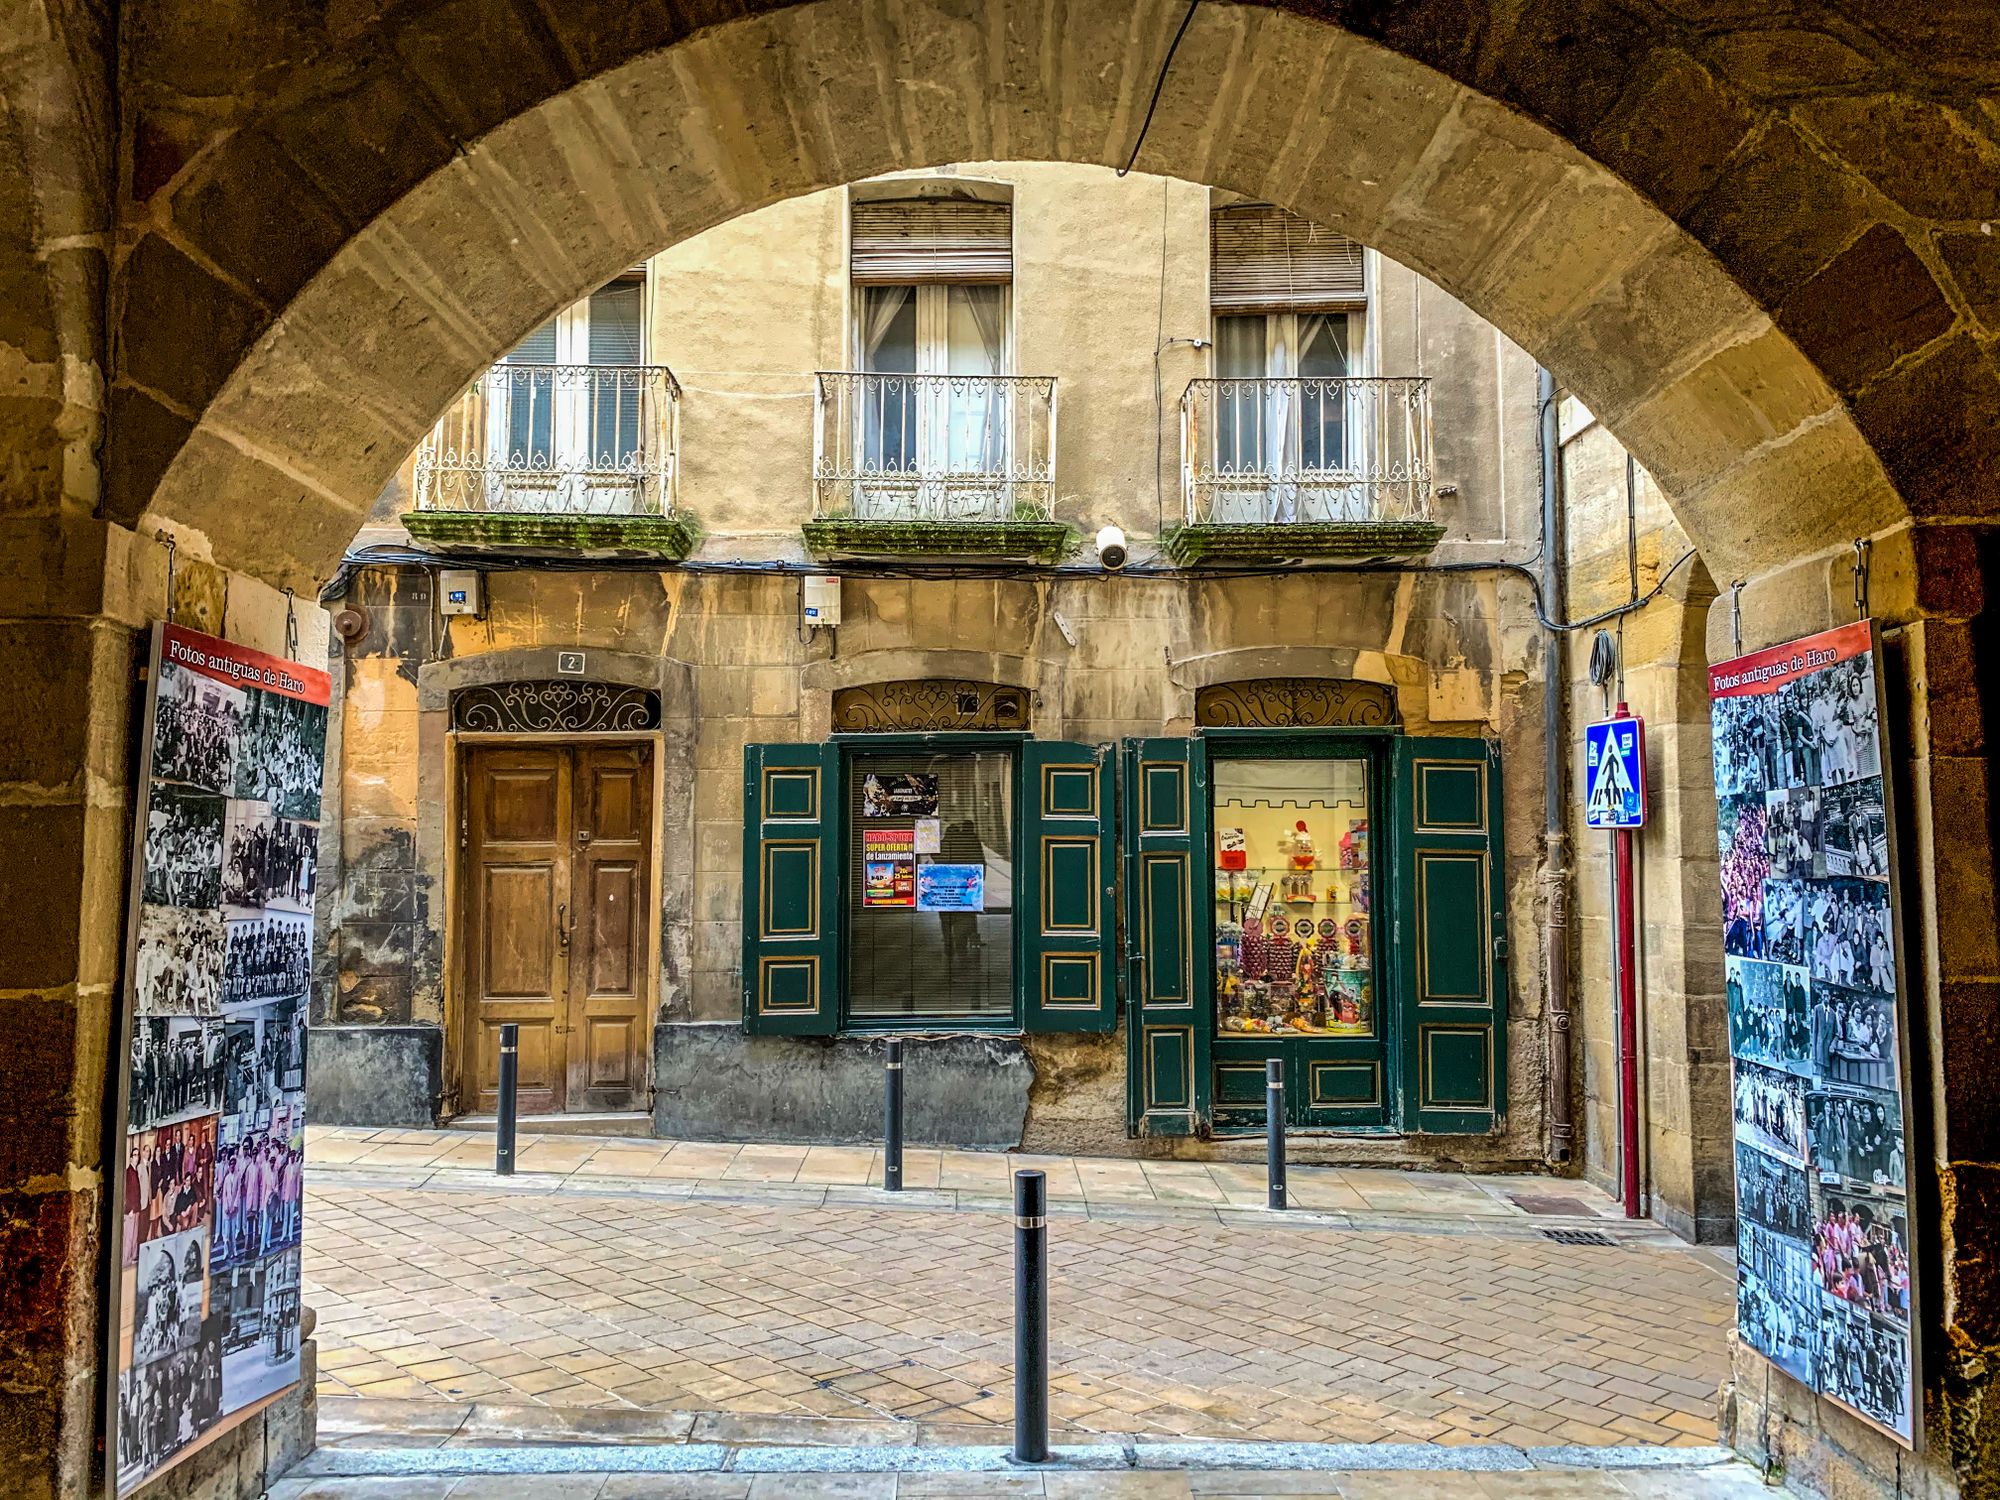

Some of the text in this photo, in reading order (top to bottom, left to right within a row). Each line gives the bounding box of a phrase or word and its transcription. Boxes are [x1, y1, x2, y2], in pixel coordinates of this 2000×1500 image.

[169, 639, 305, 693] Fotos antiguas de Haro
[567, 656, 576, 670] 2
[1713, 648, 1837, 692] Fotos antiguas de Haro
[866, 843, 886, 851] SUPER
[887, 843, 907, 851] OFERTA
[866, 852, 913, 860] de Lanzamiento
